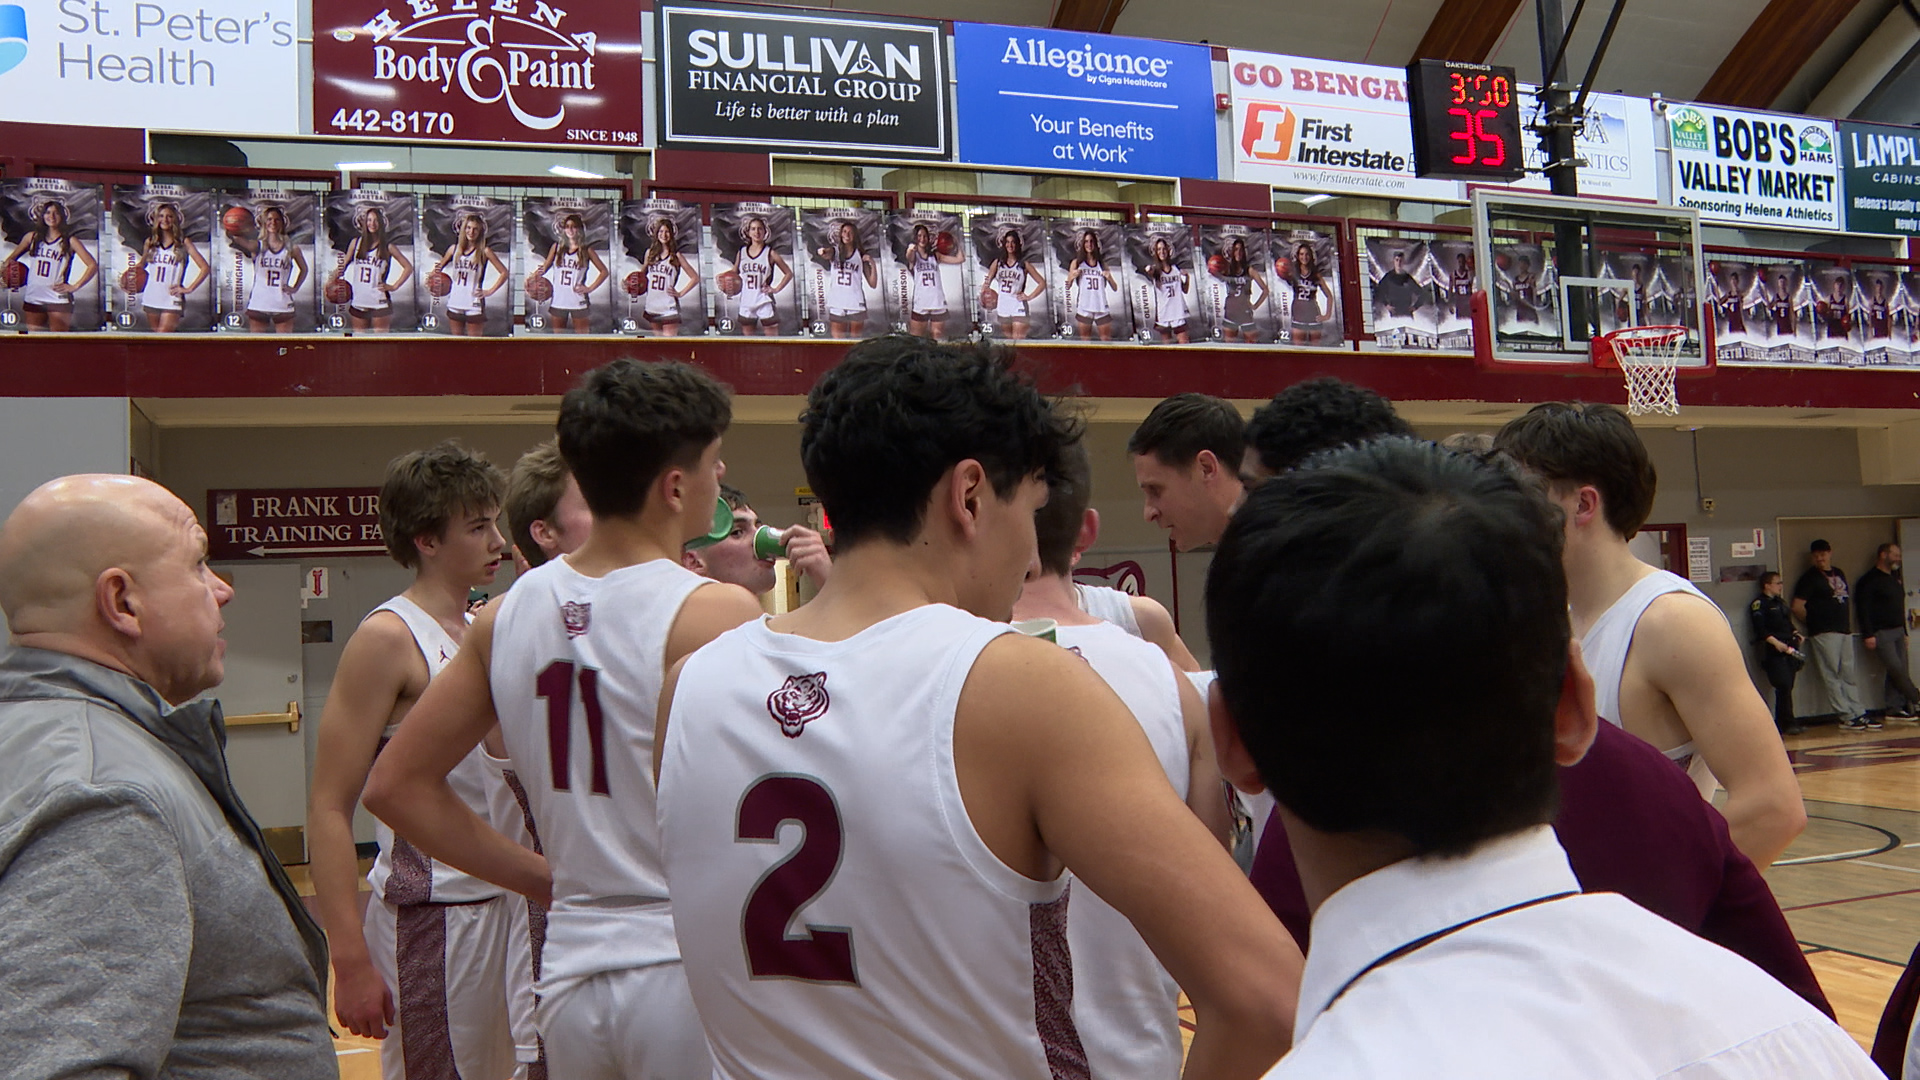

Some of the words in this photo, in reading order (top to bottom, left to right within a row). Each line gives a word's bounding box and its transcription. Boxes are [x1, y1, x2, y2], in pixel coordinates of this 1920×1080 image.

[58, 0, 119, 36] St.
[135, 3, 292, 47] Peter's
[688, 29, 921, 81] SULLIVAN
[1001, 37, 1168, 78] Allegiance
[58, 42, 215, 87] Health
[373, 45, 457, 93] Body
[508, 50, 595, 90] Paint
[1445, 61, 1491, 71] DAKTRONICS
[1086, 73, 1097, 84] by
[1098, 74, 1122, 86] Cigna
[1123, 76, 1168, 88] Healthcare
[1233, 62, 1283, 88] GO
[688, 70, 827, 97] FINANCIAL
[834, 78, 921, 102] GROUP
[331, 108, 455, 134] 442-8170
[715, 101, 745, 121] Life
[750, 103, 763, 119] is
[767, 102, 811, 121] better
[815, 105, 848, 123] with
[852, 112, 862, 124] a
[866, 109, 900, 128] plan
[1674, 109, 1706, 130] BOB'S
[1030, 113, 1074, 135] Your
[1079, 117, 1154, 141] Benefits
[1301, 118, 1353, 142] First
[566, 129, 608, 142] SINCE
[611, 130, 638, 143] 1948
[1447, 108, 1505, 166] 35
[1713, 115, 1797, 166] BOB'S
[1052, 143, 1074, 160] at
[1078, 142, 1128, 164] Work
[1298, 142, 1405, 171] Interstate
[1800, 151, 1834, 164] HAMS
[1851, 132, 1920, 168] LAMPL
[1293, 170, 1405, 190] www.firstinterstate.com
[1678, 160, 1753, 195] VALLEY
[1758, 168, 1834, 203] MARKET
[1679, 196, 1741, 217] Sponsoring
[1745, 202, 1783, 218] Helena
[1786, 206, 1833, 222] Athletics
[37, 260, 51, 277] 10
[156, 266, 166, 282] 11
[360, 266, 371, 283] 13
[235, 251, 244, 312] BERMINGHAM
[267, 270, 280, 287] 12
[457, 271, 468, 286] 14
[560, 270, 572, 286] 15
[651, 274, 666, 291] 20
[747, 274, 758, 290] 21
[837, 271, 852, 286] 23
[922, 272, 935, 286] 24
[1085, 277, 1099, 290] 30
[1001, 280, 1013, 294] 25
[2, 312, 16, 324] 10
[121, 314, 131, 325] 11
[228, 315, 240, 326] 12
[331, 316, 343, 327] 13
[425, 316, 435, 327] 14
[532, 316, 543, 328] 15
[623, 319, 636, 330] 20
[721, 319, 731, 330] 21
[813, 322, 826, 333] 23
[981, 323, 993, 333] 25
[1061, 325, 1073, 335] 30
[1141, 330, 1151, 339] 31
[1214, 328, 1220, 337] 5
[1280, 330, 1290, 340] 22
[252, 495, 340, 518] FRANK
[347, 495, 381, 516] UR
[225, 524, 352, 544] TRAINING
[361, 523, 384, 541] FA
[536, 658, 612, 798] 11
[734, 771, 862, 988] 2
